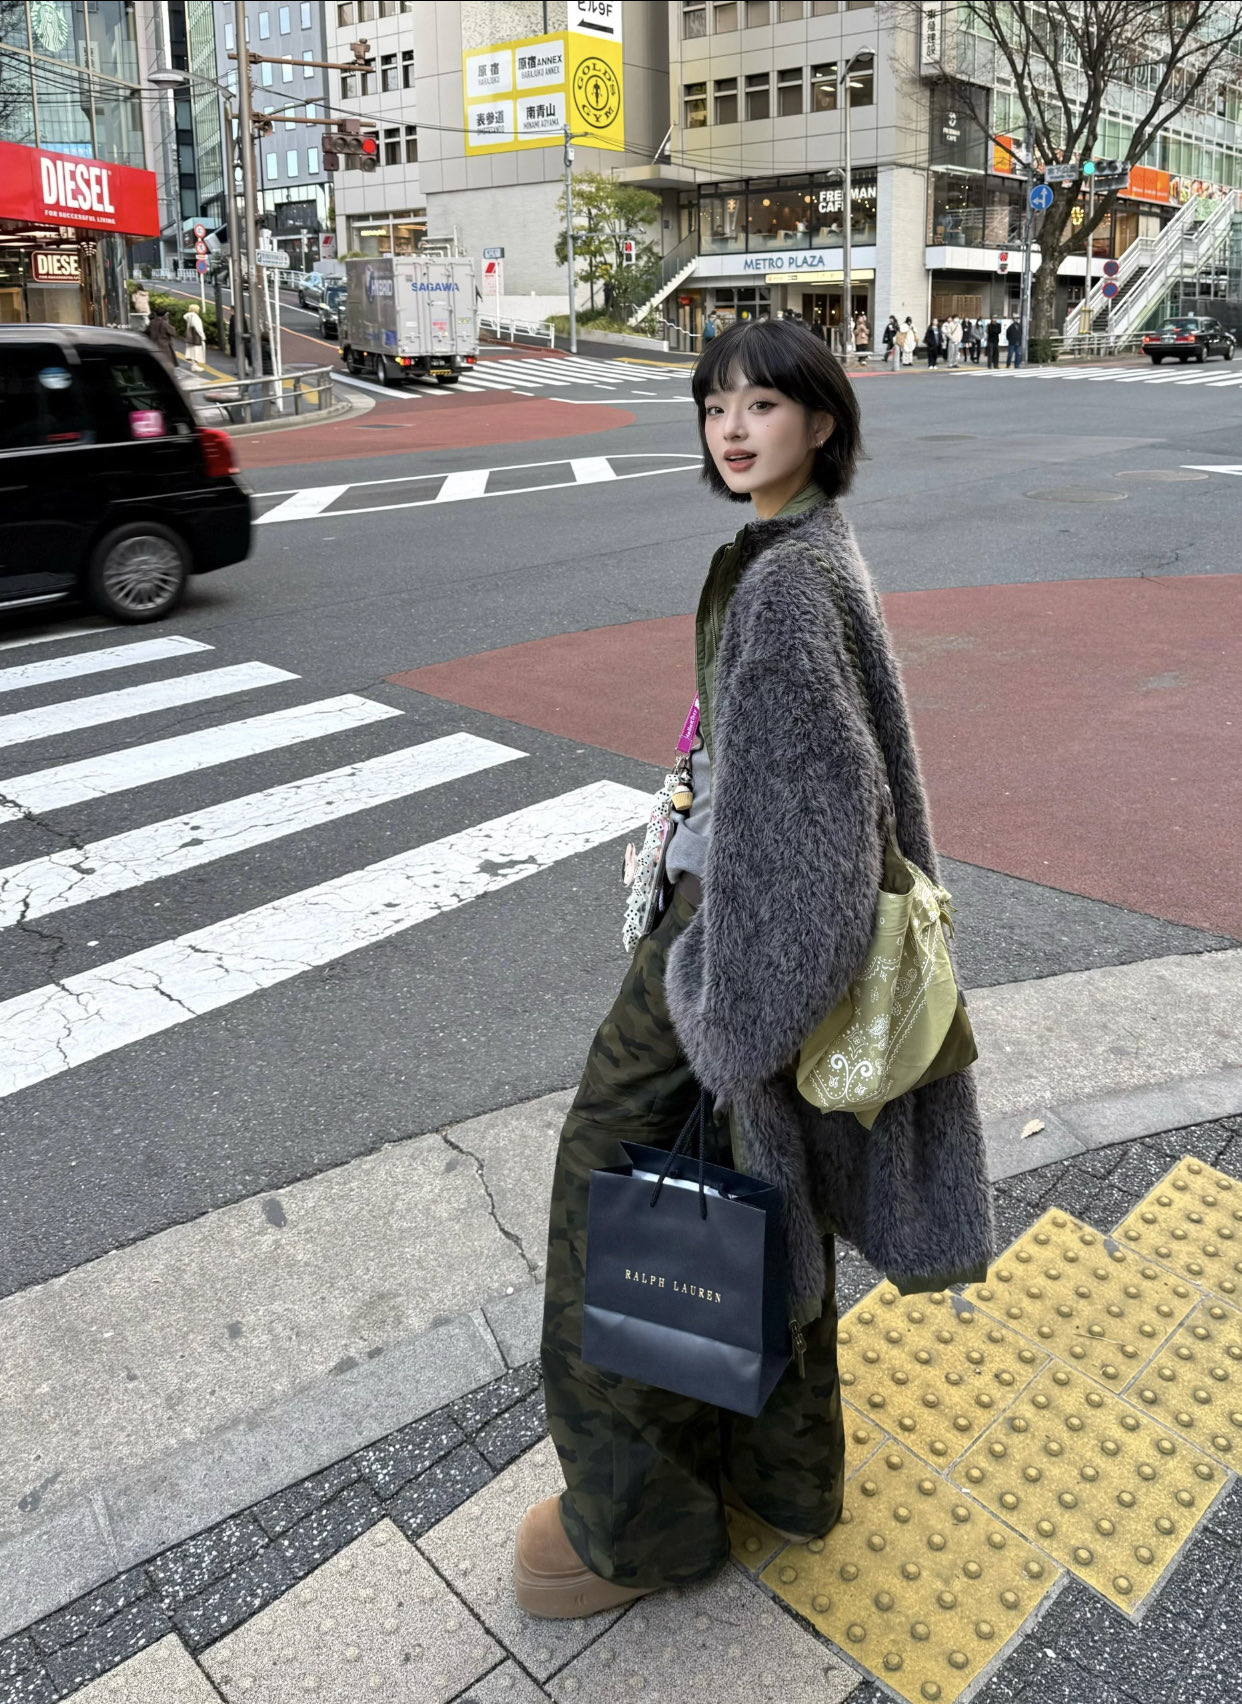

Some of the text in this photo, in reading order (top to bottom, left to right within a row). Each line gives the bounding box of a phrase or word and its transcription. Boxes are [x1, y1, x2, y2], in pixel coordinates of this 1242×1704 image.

[478, 62, 499, 77] 原宿
[545, 66, 560, 76] ANNEX
[577, 62, 616, 97] GOLD'S
[476, 110, 504, 127] 表参道
[526, 102, 556, 120] 南青山
[582, 104, 615, 123] GYM
[40, 157, 116, 214] DIESEL
[819, 186, 877, 203] FREMAN
[818, 201, 844, 214] CAF
[45, 209, 116, 225] FOR SUCCESSFUL LIVING
[37, 254, 80, 276] DIESE
[744, 255, 825, 271] METRO PLAZA
[411, 282, 460, 292] SAGAWA
[625, 1269, 722, 1304] RALPH LAUREN
